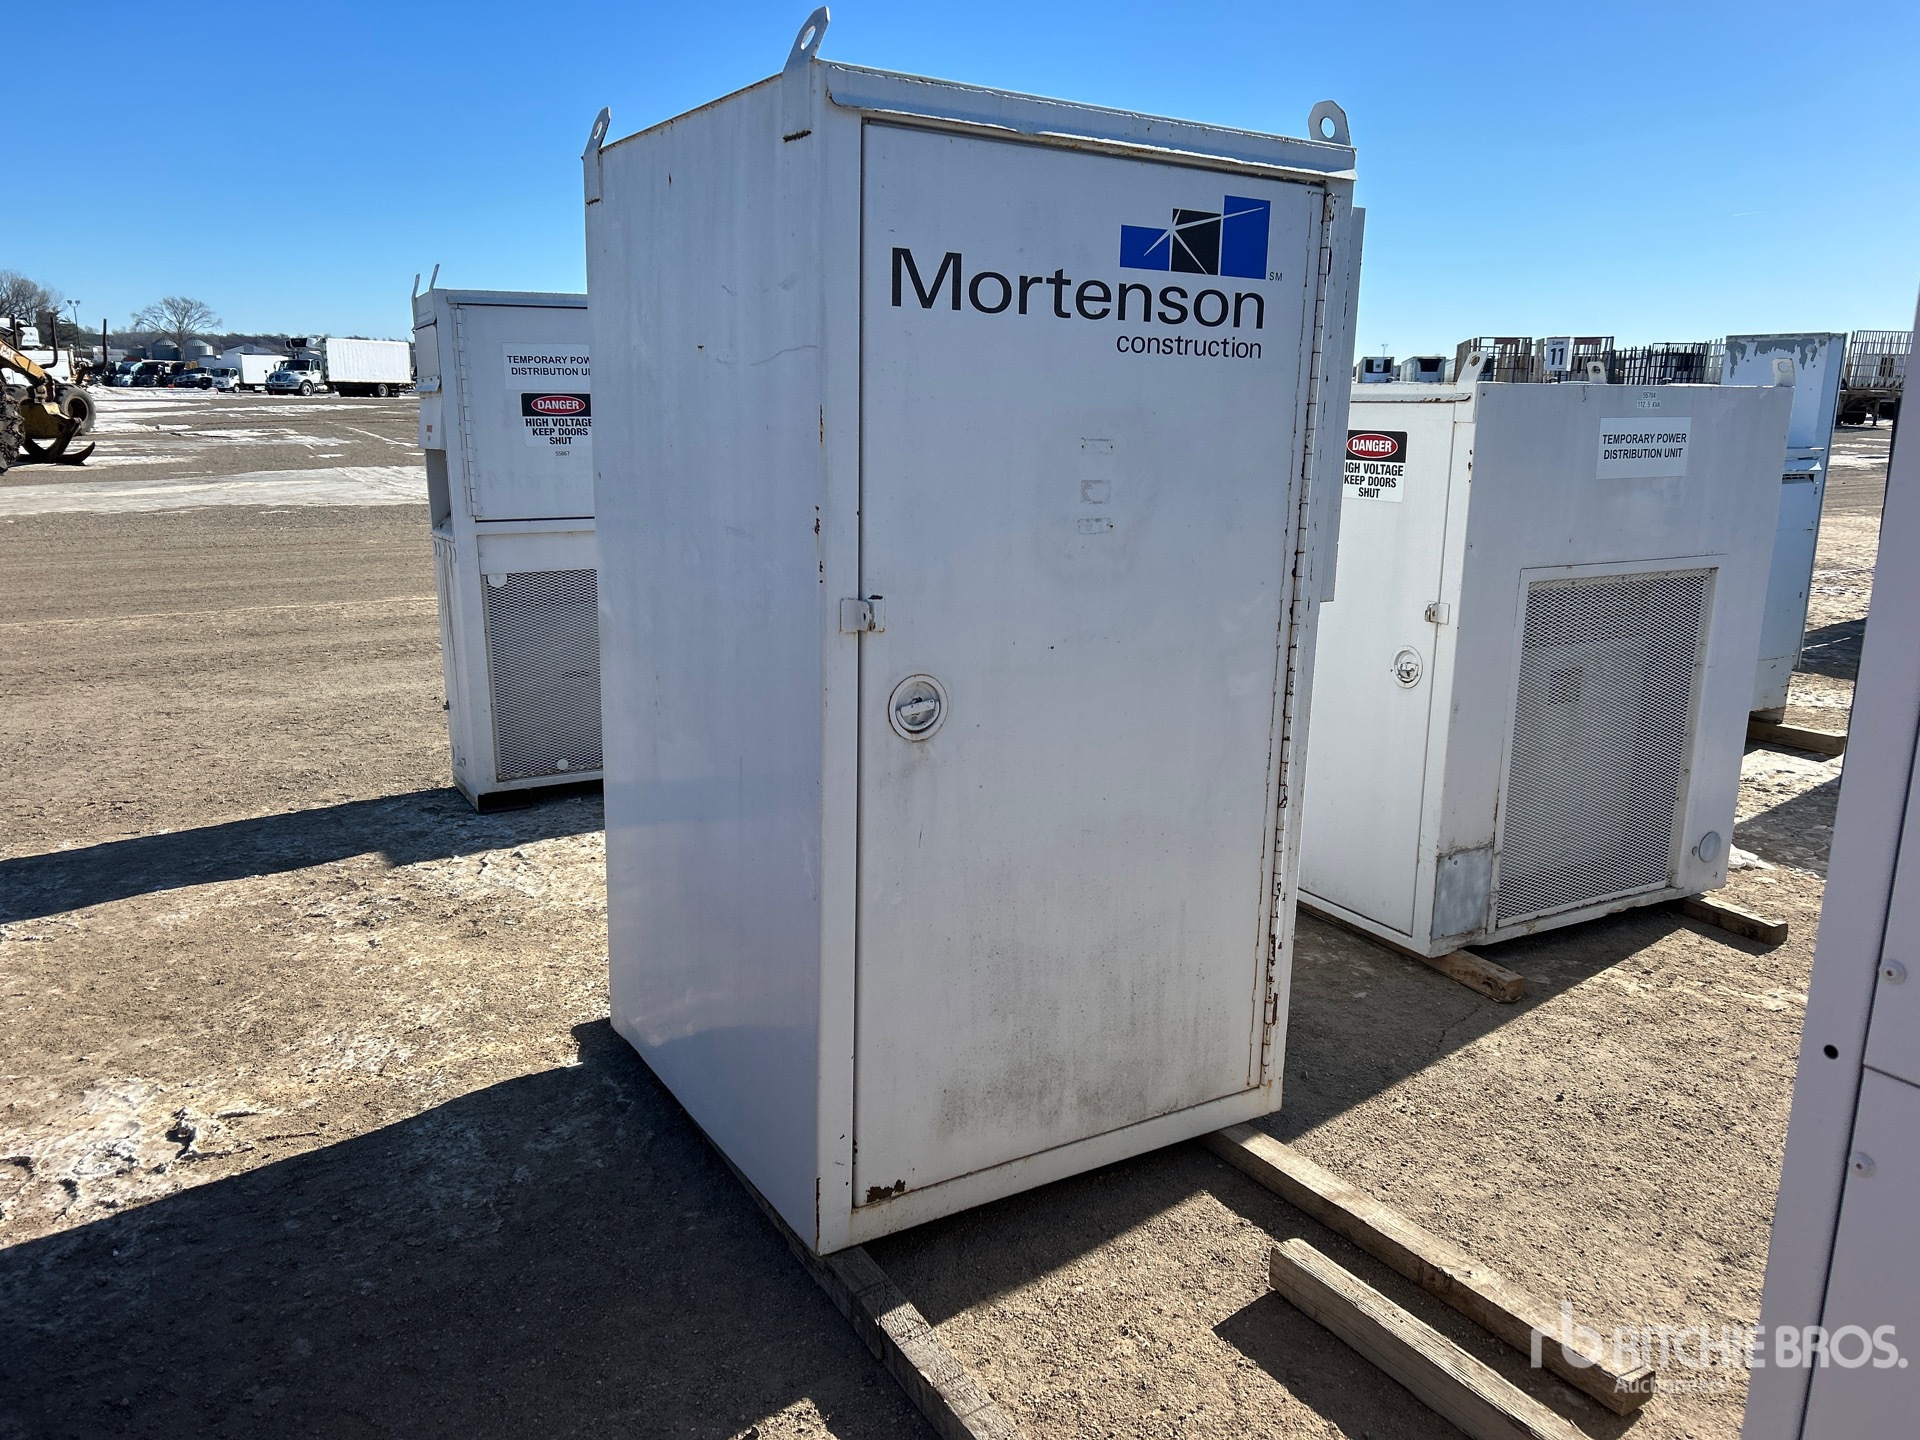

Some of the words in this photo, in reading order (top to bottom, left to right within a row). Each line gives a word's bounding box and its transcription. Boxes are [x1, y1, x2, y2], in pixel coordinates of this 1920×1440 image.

[1269, 271, 1283, 281] SM
[891, 247, 1266, 329] Mortenson
[1116, 334, 1262, 359] construction
[507, 355, 568, 364] TEMPORARY
[570, 356, 591, 364] POW
[1550, 347, 1565, 366] 11
[511, 367, 579, 376] DISTRIBUTION
[537, 400, 580, 410] DANGER
[525, 418, 549, 427] HIGH
[551, 418, 592, 427] VOLTAGE
[532, 428, 556, 436] KEEP
[558, 428, 589, 436] DOORS
[549, 437, 573, 445] SHUT
[1602, 434, 1656, 445] TEMPORARY
[1656, 433, 1687, 443] POWER
[1352, 439, 1392, 452] DANGER
[1603, 448, 1663, 460] DISTRIBUTION
[1664, 448, 1684, 458] UNIT
[1345, 462, 1360, 473] IGH
[1363, 463, 1404, 476] VOLTAGE
[1344, 475, 1366, 485] KEEP
[1368, 476, 1397, 488] DOORS
[1358, 487, 1381, 498] SHUT
